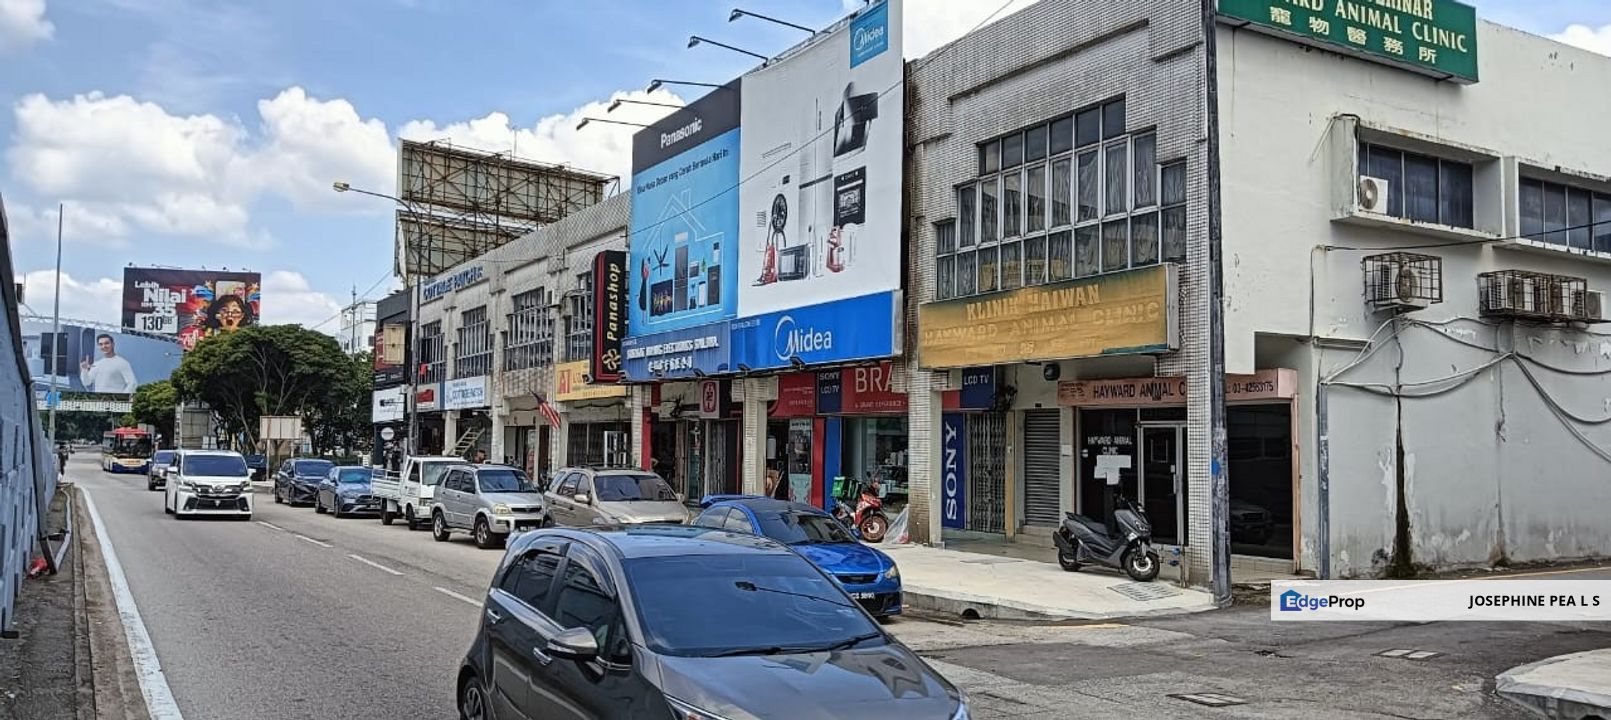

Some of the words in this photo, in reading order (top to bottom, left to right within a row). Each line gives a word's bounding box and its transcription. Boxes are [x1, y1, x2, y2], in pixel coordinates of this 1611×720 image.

[1335, 0, 1402, 34] ANIMAL
[1411, 21, 1468, 53] CLINIC
[660, 117, 702, 149] Panasonic
[143, 288, 187, 303] Nilai
[606, 262, 622, 341] Panashop
[153, 302, 177, 316] 35
[141, 315, 163, 331] 130
[775, 315, 832, 360] Midea
[819, 371, 839, 381] SONY
[964, 375, 978, 386] LCD
[980, 374, 990, 385] TV
[1093, 383, 1135, 399] HAYWARD
[1140, 381, 1174, 399] ANIMAL
[945, 421, 957, 520] SONY
